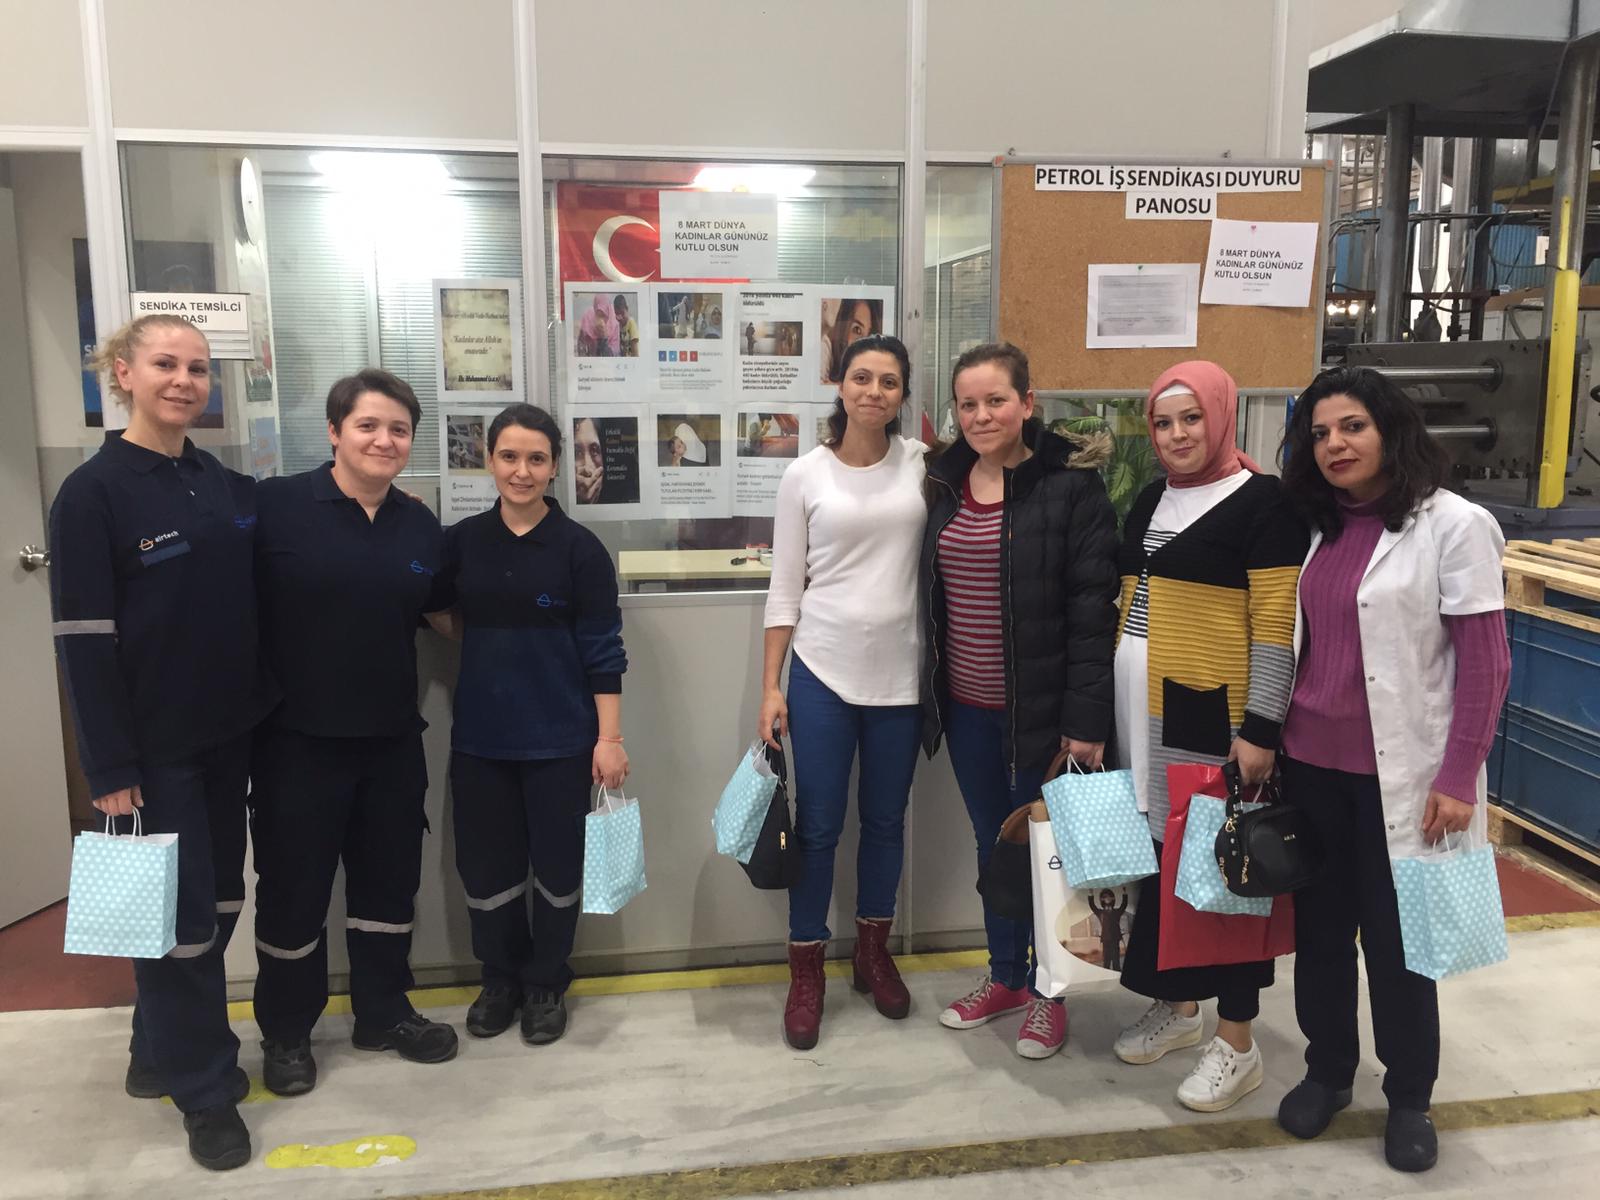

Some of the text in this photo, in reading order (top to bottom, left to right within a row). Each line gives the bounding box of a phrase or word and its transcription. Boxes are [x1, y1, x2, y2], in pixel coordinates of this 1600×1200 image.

[1036, 166, 1300, 189] PETROL İŞ SENDİKASI DUYURU
[1135, 197, 1211, 214] PANOSU
[678, 220, 746, 230] 8 MART DÜNYA
[675, 231, 768, 241] KADINLAR GÜNÜNÜZ
[675, 243, 739, 252] KUTLU OLSUN
[1219, 248, 1281, 259] 8 MART DÜNYA
[1216, 260, 1304, 270] KADINLAR GÜNÜNÜZ
[1214, 271, 1272, 280] KUTLU OLSUN
[139, 300, 241, 312] SENDİKA TEMSİLCİ
[178, 314, 208, 324] DASI
